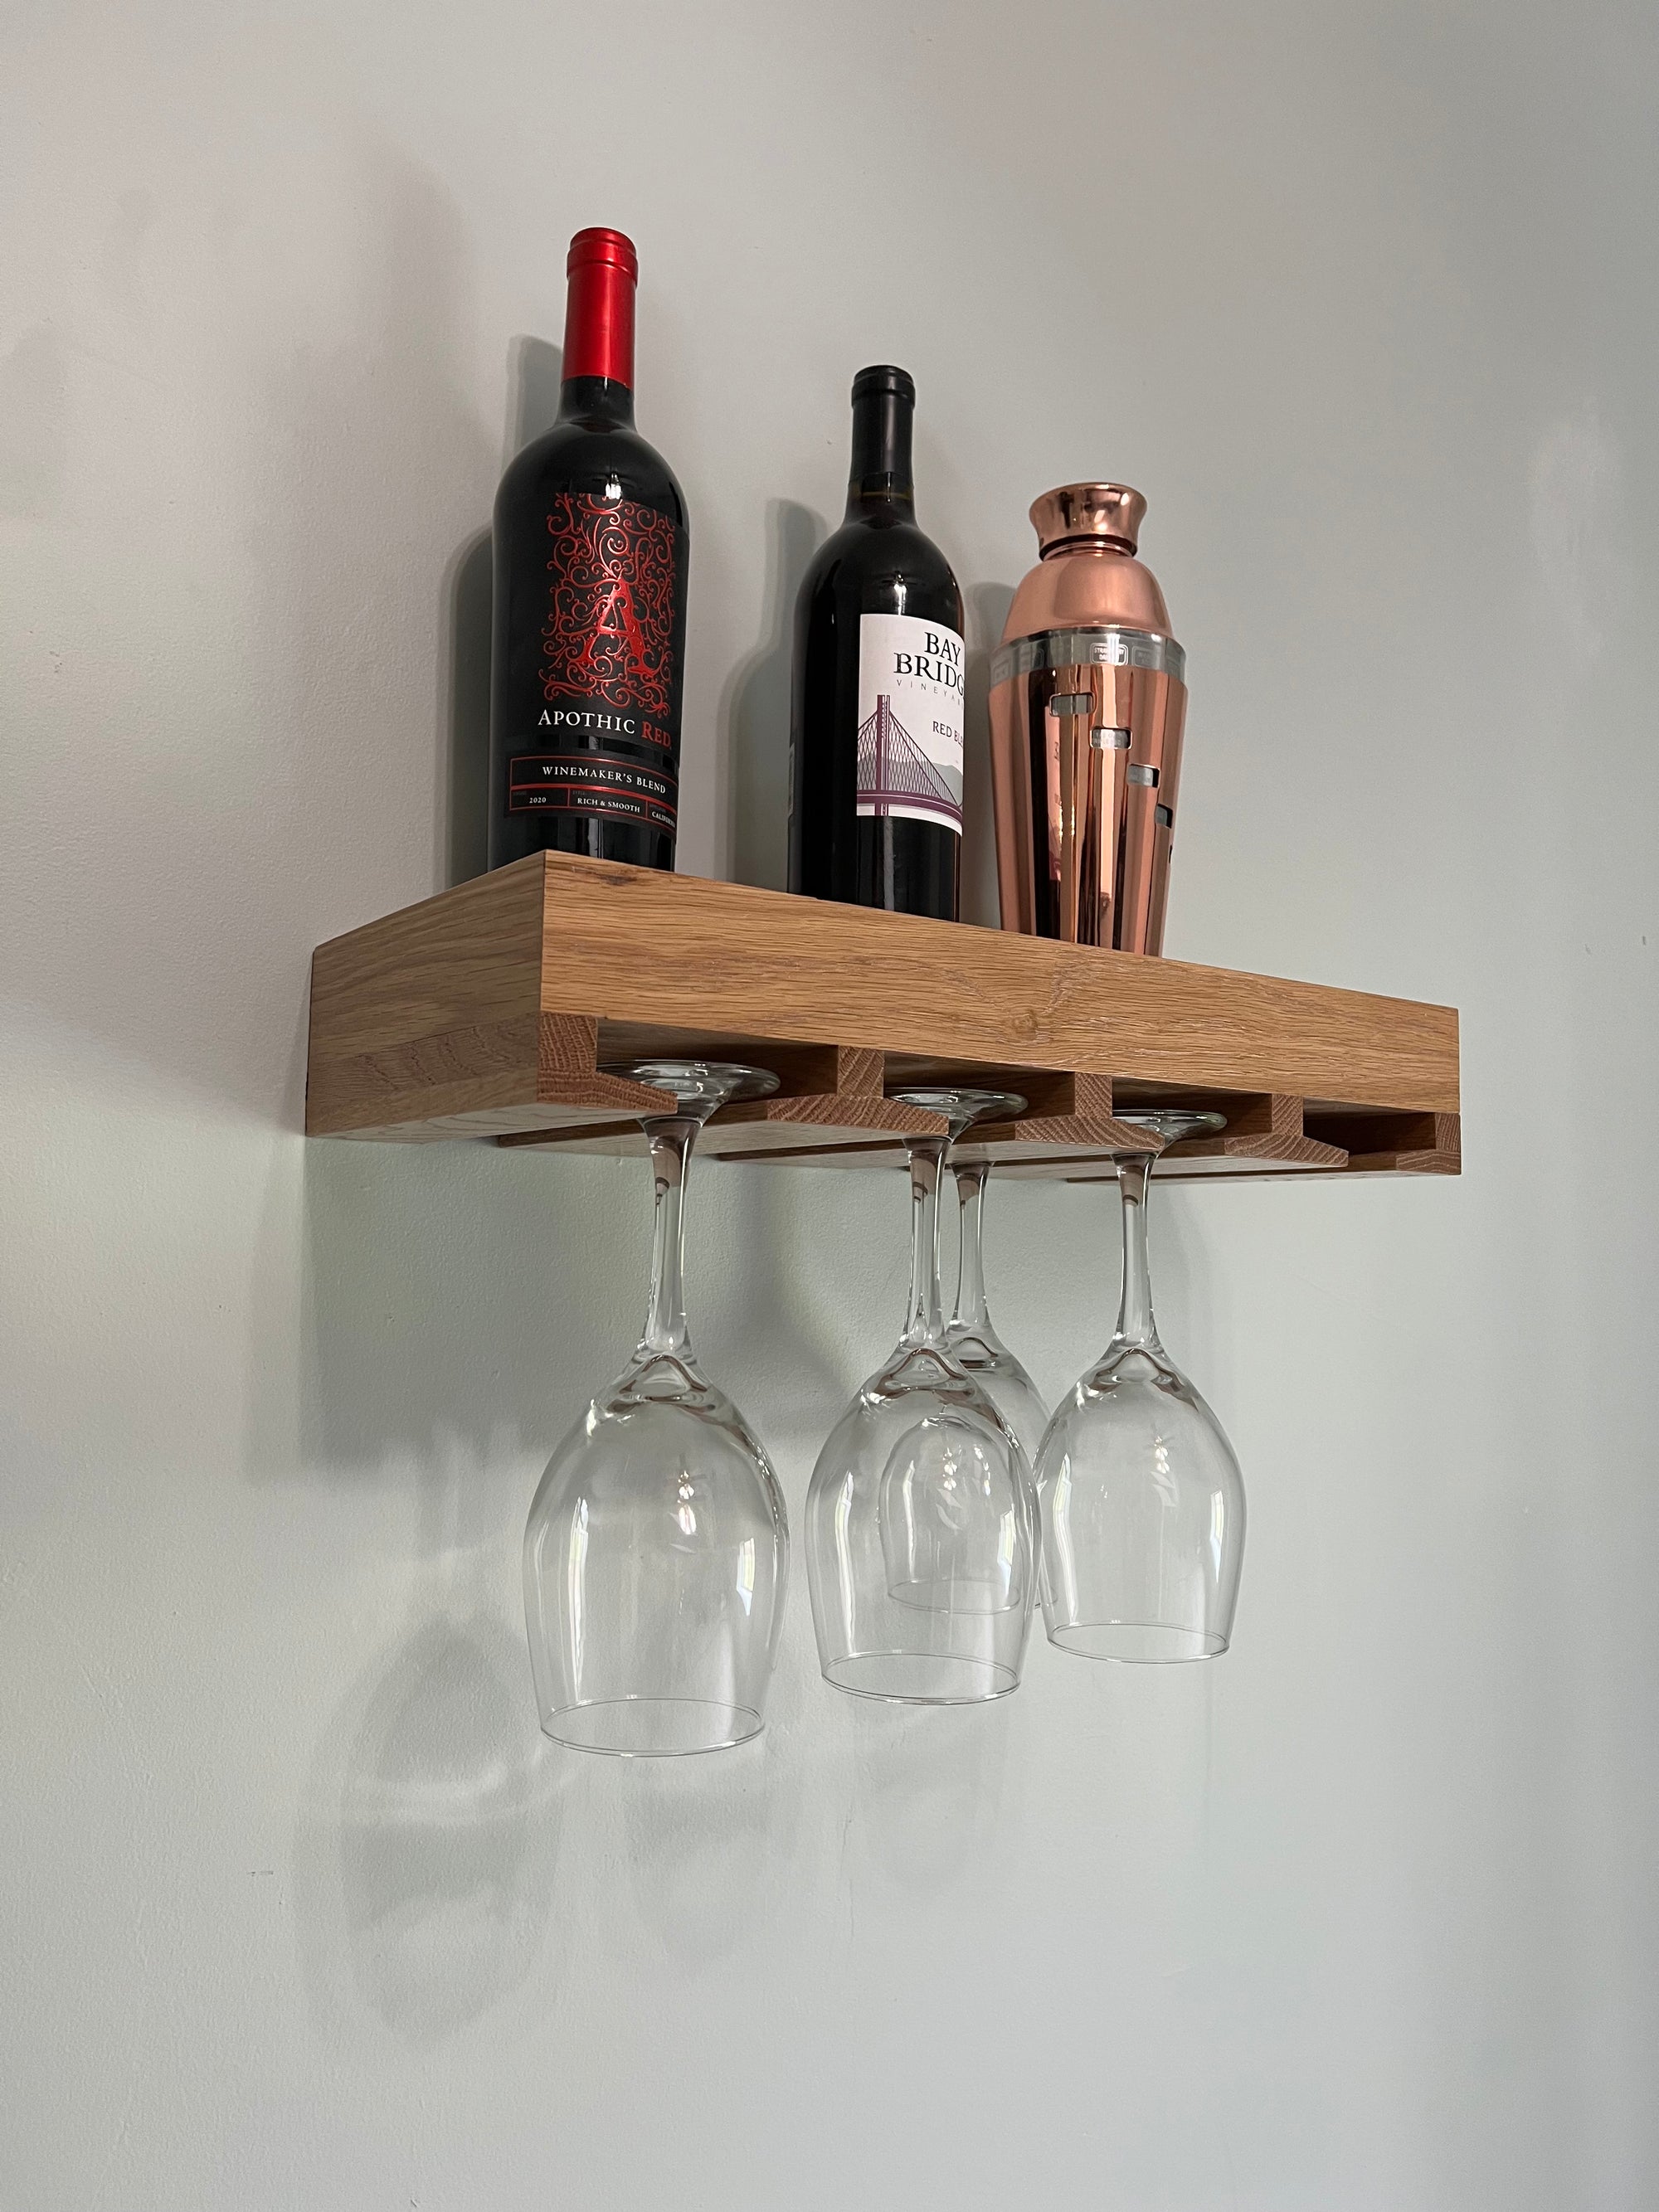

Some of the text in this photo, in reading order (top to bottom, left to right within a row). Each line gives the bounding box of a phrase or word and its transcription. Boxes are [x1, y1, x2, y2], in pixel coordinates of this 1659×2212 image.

[924, 631, 961, 667] BAY
[893, 652, 964, 697] BRIDG
[538, 709, 672, 747] APOTHIC RED
[932, 721, 952, 738] RED
[542, 766, 666, 794] WINEMAKER'S BLEND
[577, 797, 598, 806] RICH
[607, 801, 640, 814] SMOOTH
